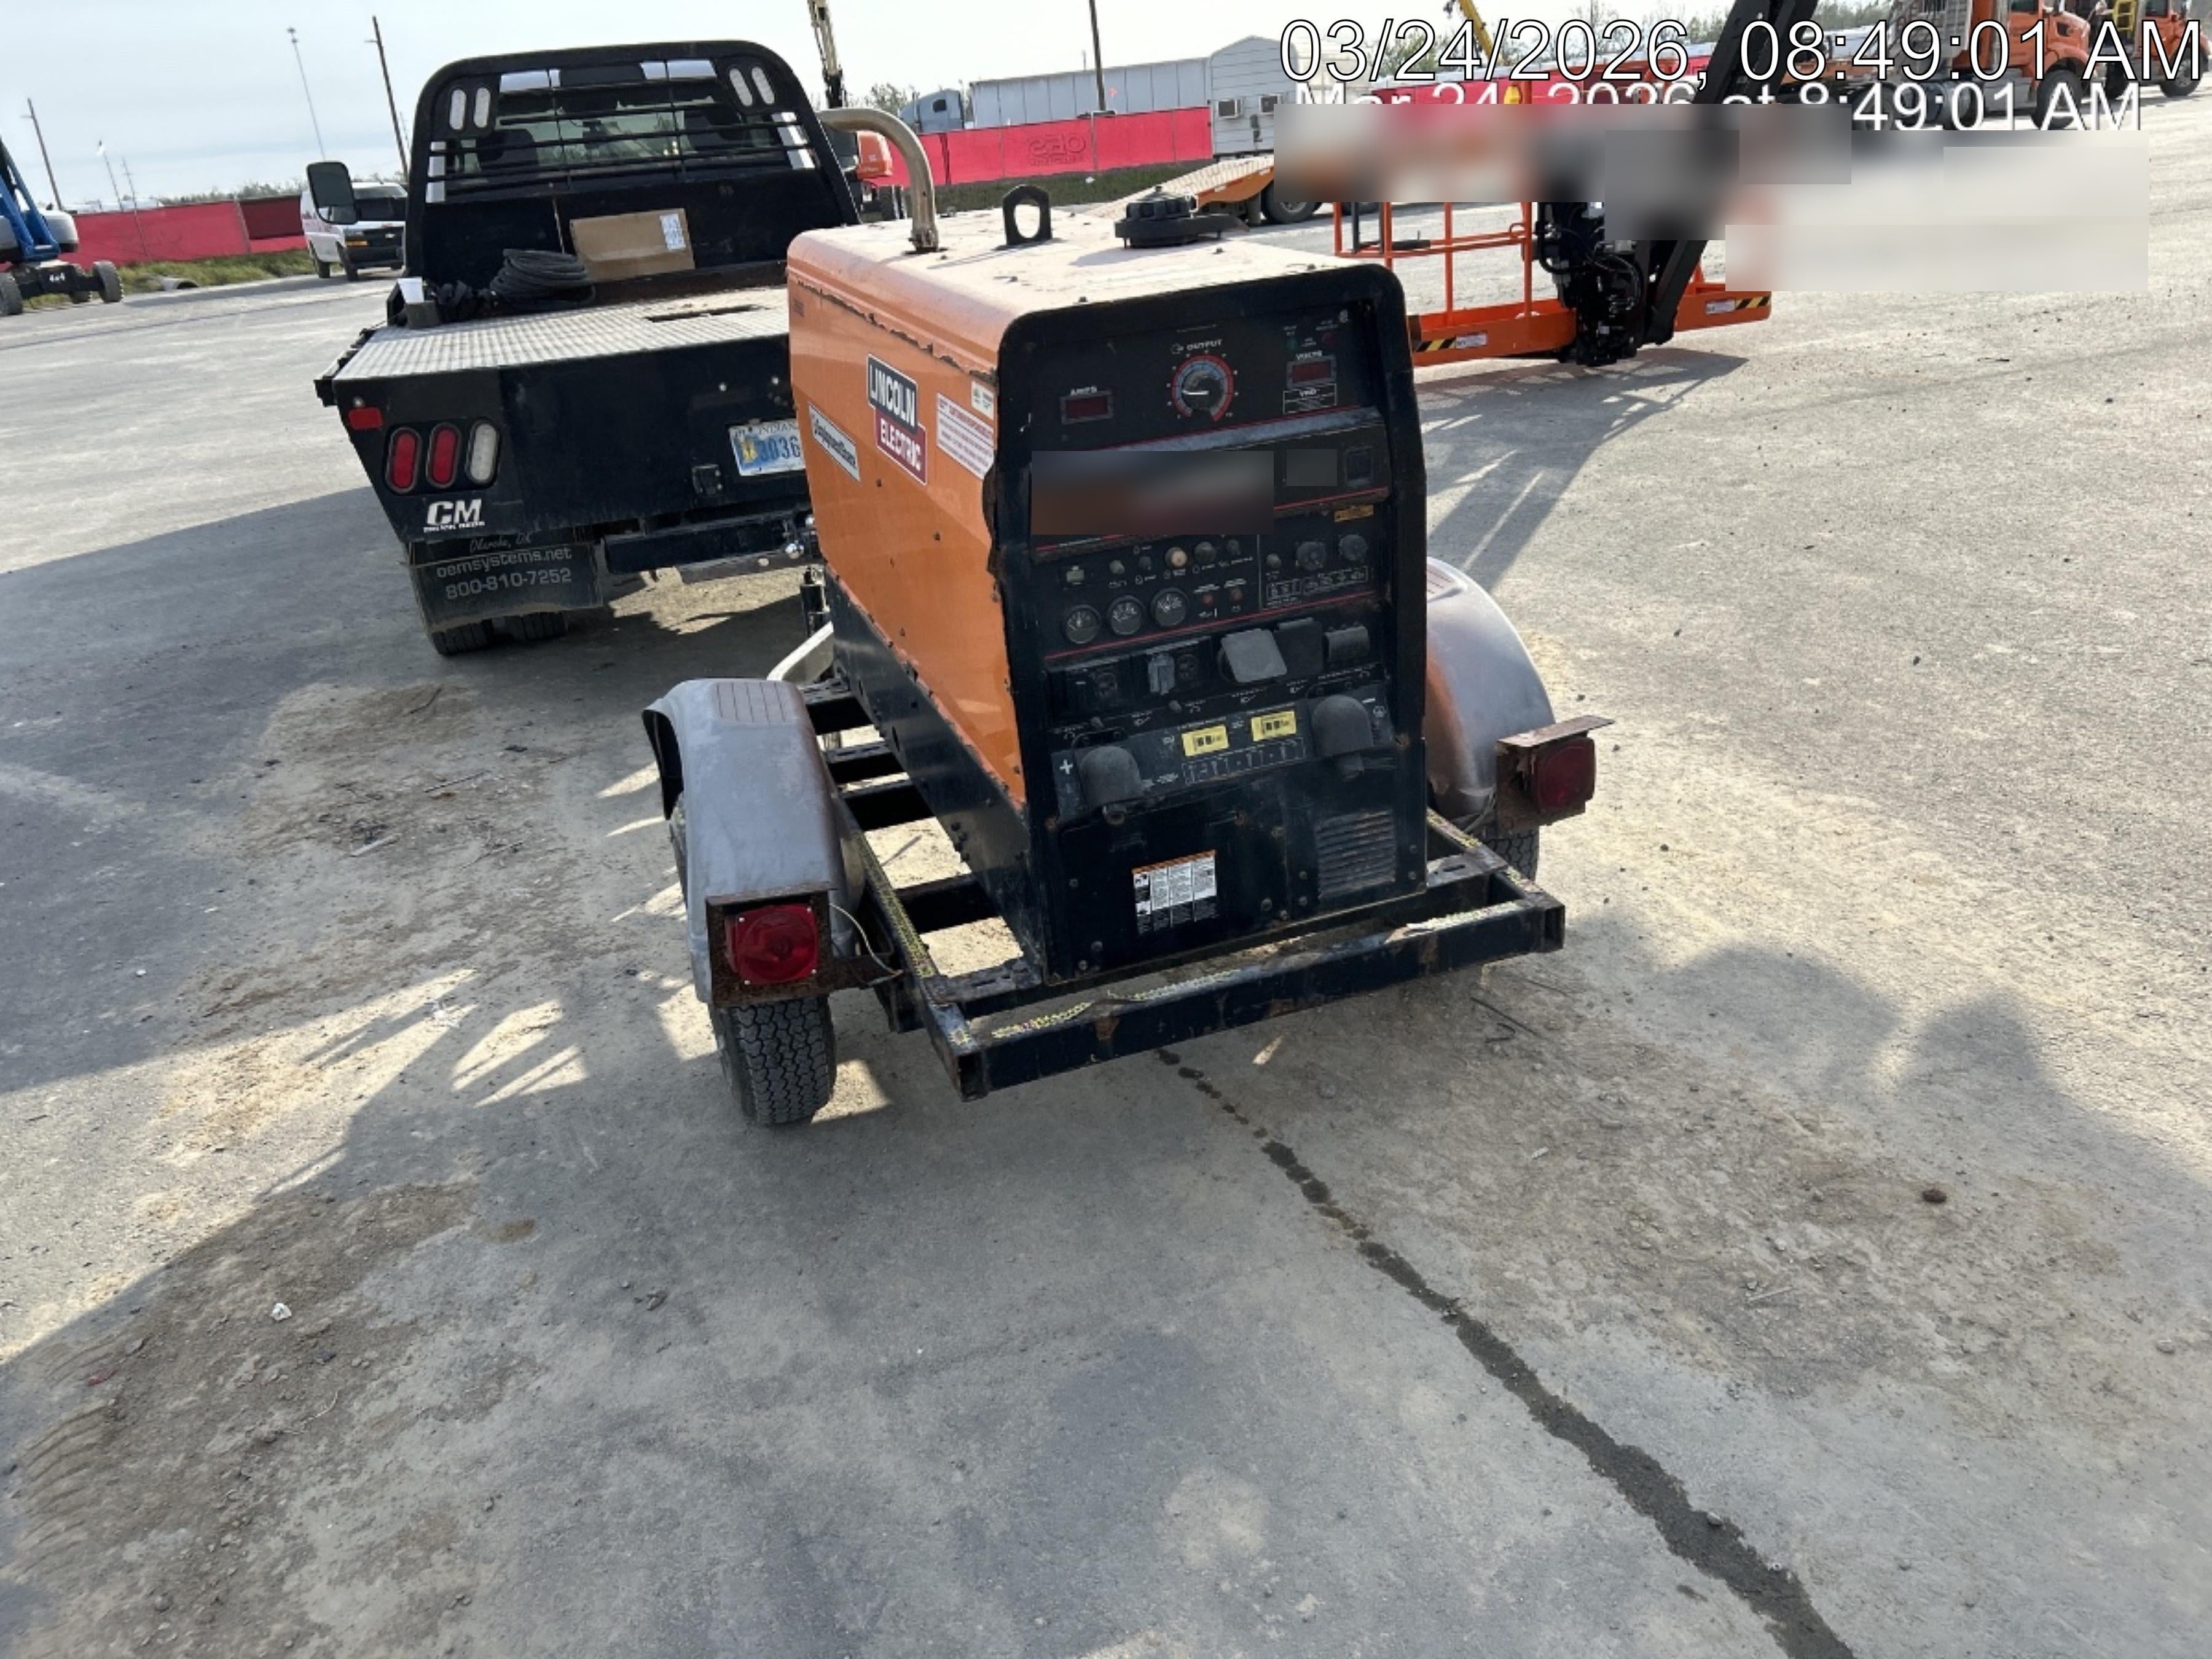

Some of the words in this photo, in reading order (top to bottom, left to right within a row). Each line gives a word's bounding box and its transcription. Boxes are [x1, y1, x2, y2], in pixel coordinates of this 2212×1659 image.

[1186, 339, 1223, 351] OUTPUT
[869, 364, 916, 427] LINCOLN
[427, 498, 482, 526] CM
[437, 547, 571, 578] oemsystems.net
[446, 567, 572, 600] 800-810-7252
